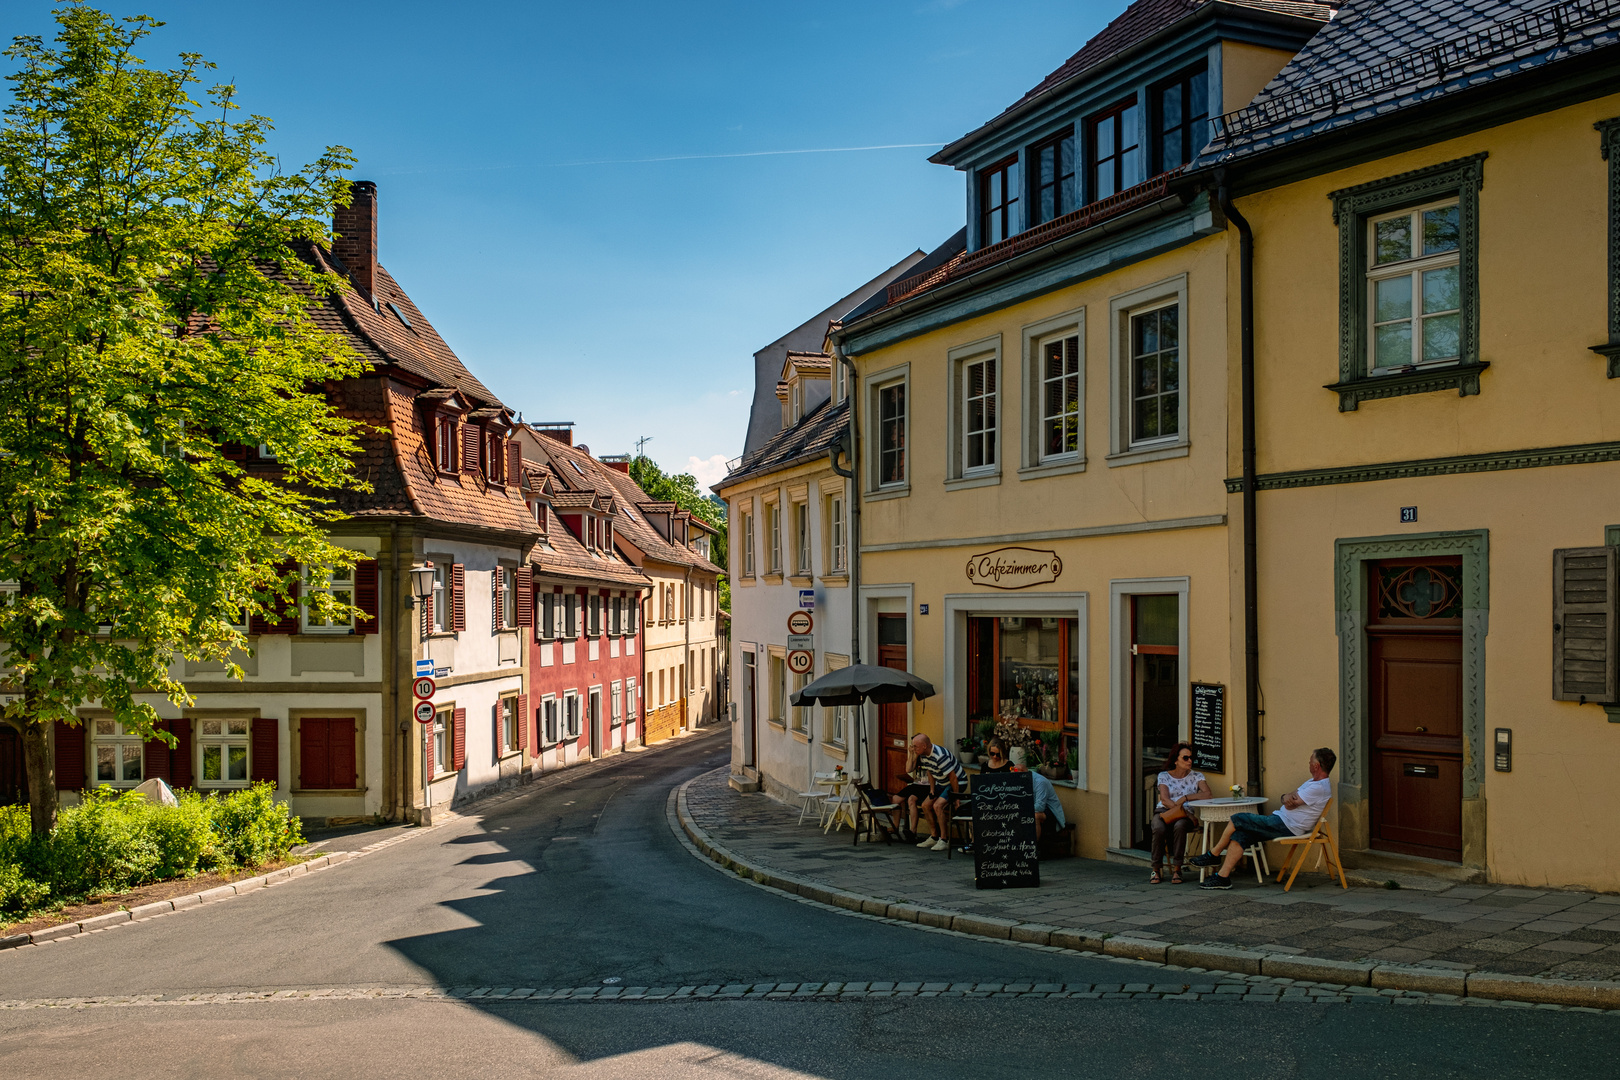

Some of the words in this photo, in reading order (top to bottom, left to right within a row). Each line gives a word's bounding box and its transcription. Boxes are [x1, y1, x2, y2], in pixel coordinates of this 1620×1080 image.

[1403, 509, 1414, 520] 31
[978, 557, 1048, 582] Cafézimmer
[793, 655, 808, 667] 10
[418, 683, 430, 694] 10
[998, 836, 1012, 844] mit
